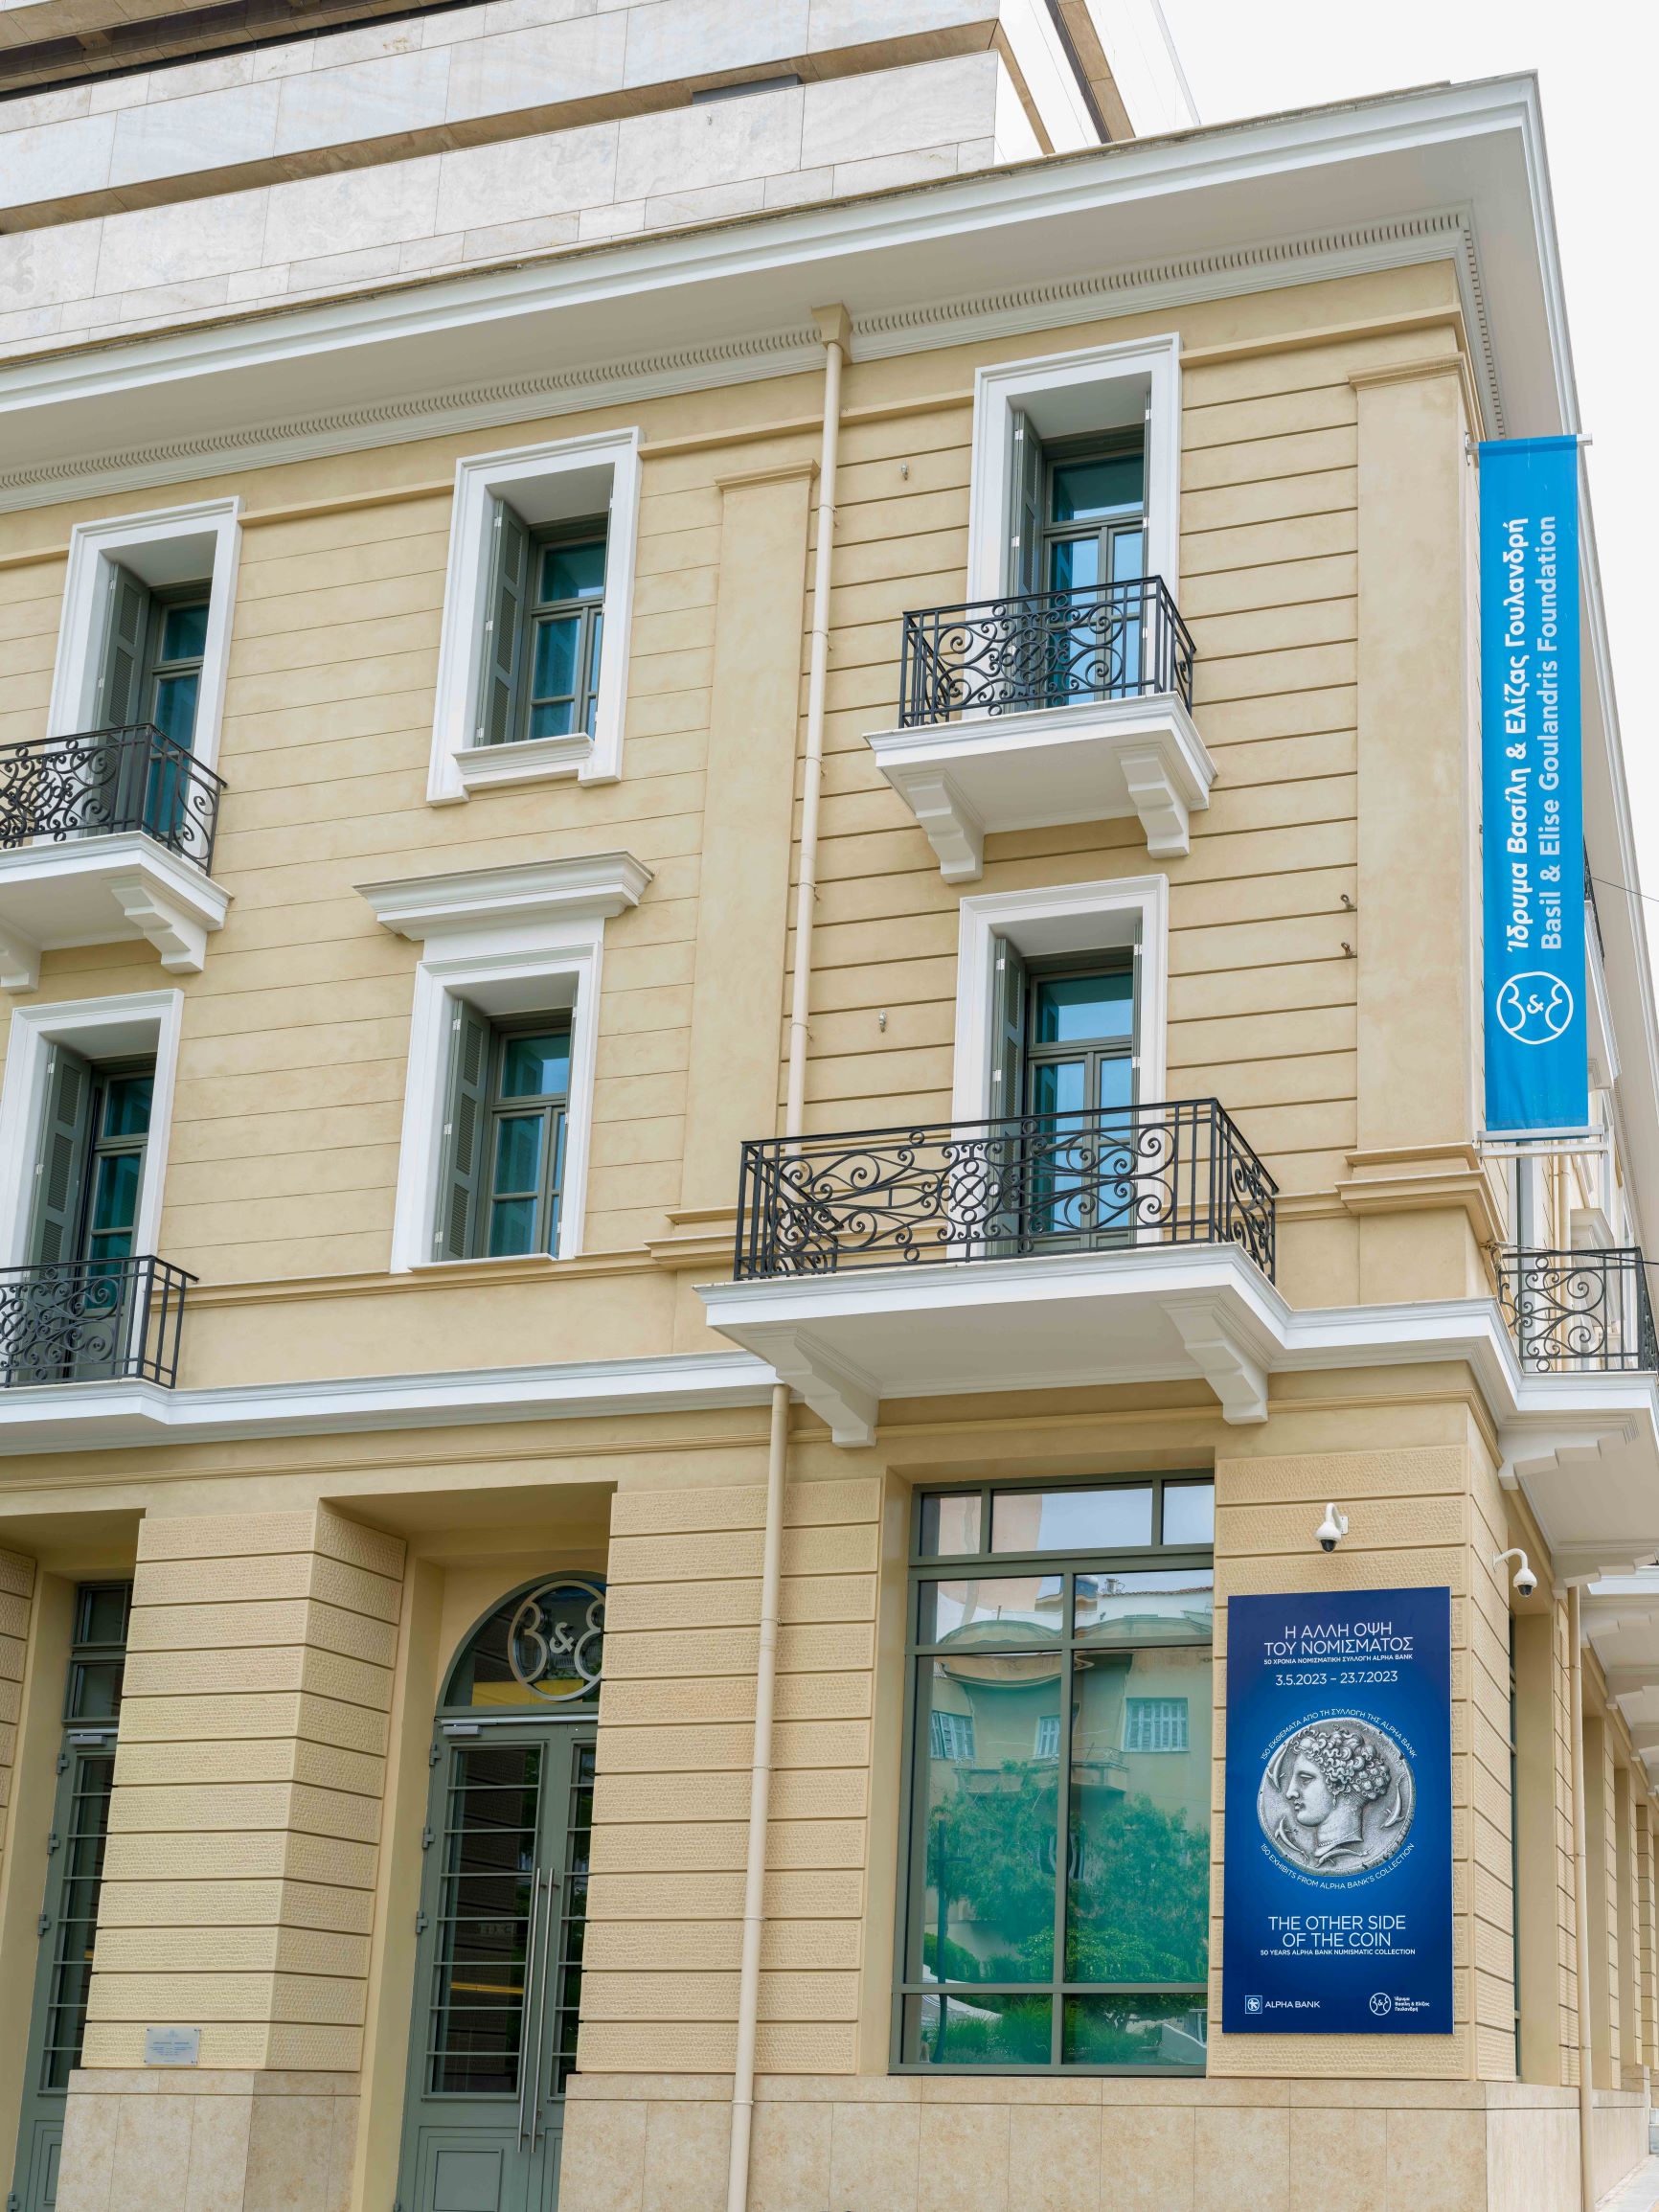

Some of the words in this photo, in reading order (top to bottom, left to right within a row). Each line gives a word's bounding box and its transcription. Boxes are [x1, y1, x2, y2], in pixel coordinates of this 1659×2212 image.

[1503, 517, 1529, 648] Γουλανδρή
[1534, 516, 1557, 651] Foundation
[1504, 654, 1530, 734] Ελίζας
[1535, 660, 1560, 791] Goulandris
[1506, 741, 1528, 760] &
[1505, 767, 1532, 854] Βασίλη
[1537, 799, 1560, 855] Elise
[1539, 863, 1560, 882] &
[1506, 862, 1533, 953] Ίδρυμα
[1538, 891, 1562, 949] Basil
[1263, 1642, 1297, 1656] ΤΟΥ
[1301, 1636, 1414, 1655] ΝΟΜΙΣΜΑΤΟΣ
[1284, 1626, 1296, 1639] Η
[1301, 1624, 1349, 1639] ΑΛΛΗ
[1353, 1621, 1392, 1637] ΟΨΗ
[1275, 1673, 1328, 1686] 3.5.2023
[1340, 1670, 1398, 1684] 23.7.2023
[1260, 1748, 1271, 1760] 150
[1268, 1720, 1302, 1749] ΕΚΘΕΜΑΤΑ
[1303, 1712, 1319, 1722] ΑΠΟ
[1330, 1708, 1366, 1718] ΣΥΛΛΟΓΗ
[1367, 1713, 1381, 1723] ΤΗΣ
[1400, 1738, 1418, 1758] BANK
[1260, 1842, 1271, 1856] 150
[1268, 1855, 1297, 1879] EXHIBITS
[1297, 1875, 1319, 1887] FROM
[1347, 1875, 1375, 1889] BANK'S
[1375, 1842, 1415, 1880] COLLECTION
[1267, 1916, 1301, 1930] THE
[1306, 1915, 1363, 1930] OTHER
[1368, 1915, 1406, 1930] SIDE
[1282, 1932, 1307, 1948] OF
[1310, 1932, 1345, 1948] THE
[1349, 1932, 1391, 1947] COIN
[1264, 2000, 1294, 2009] ALPHA
[1294, 2000, 1321, 2009] BANK
